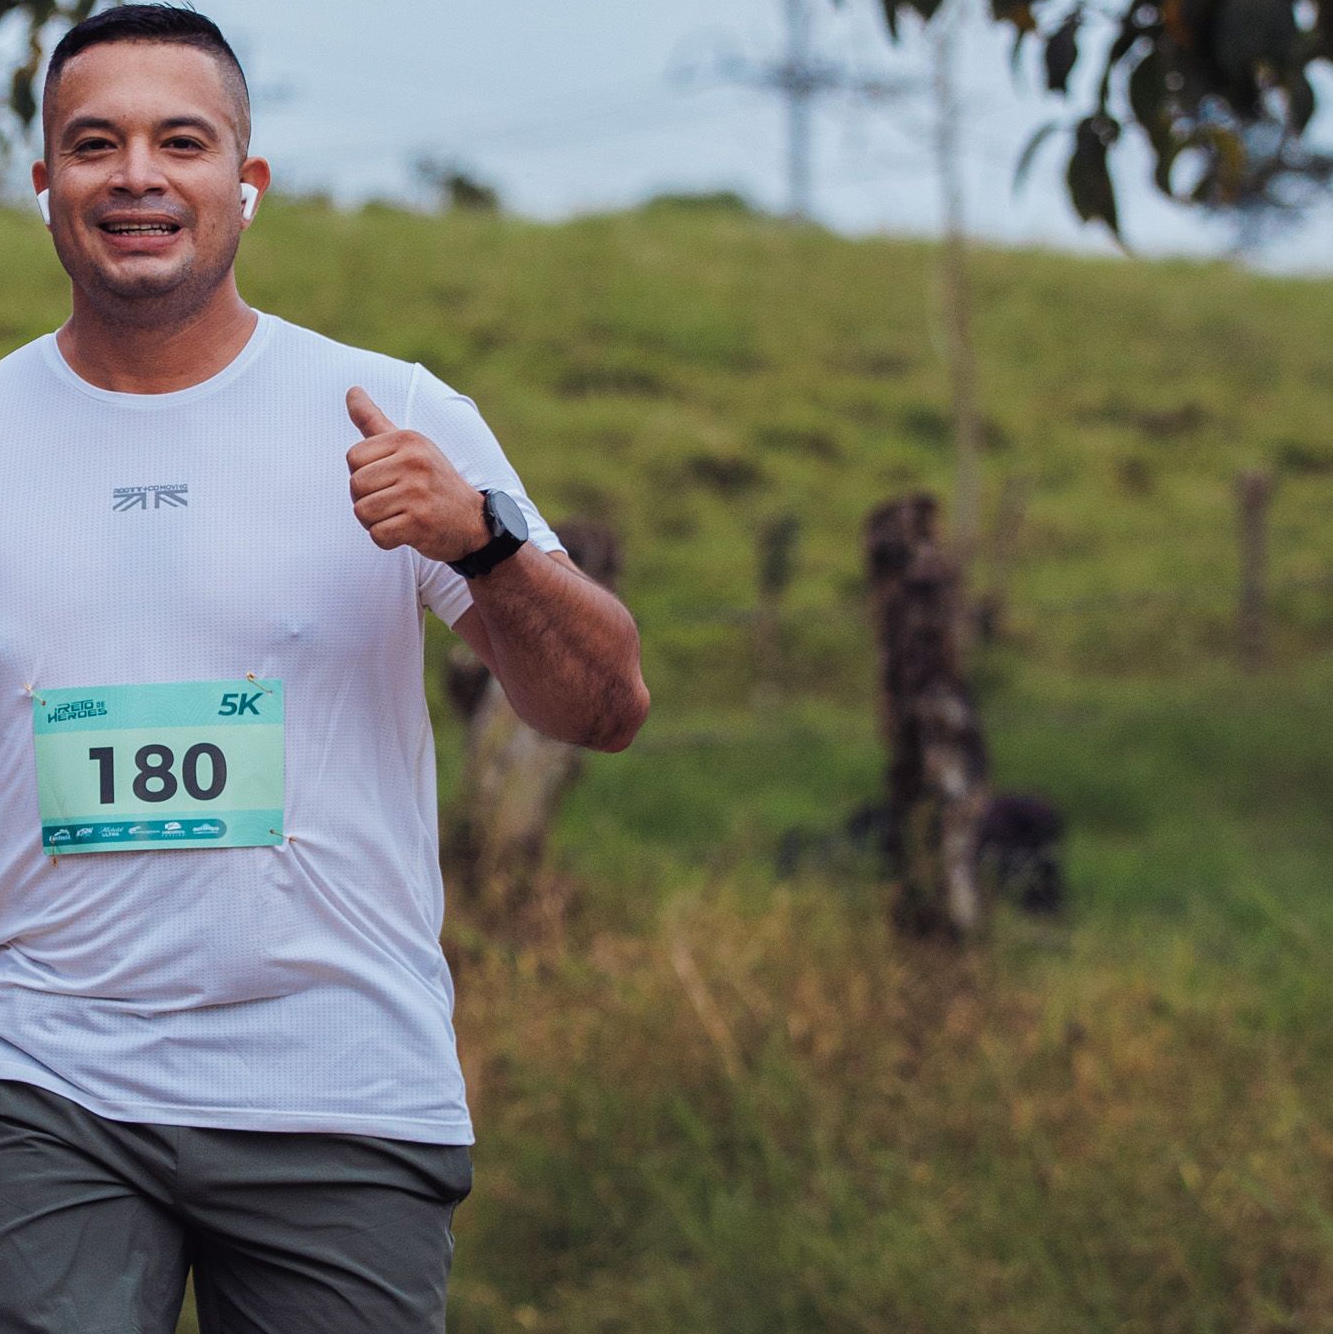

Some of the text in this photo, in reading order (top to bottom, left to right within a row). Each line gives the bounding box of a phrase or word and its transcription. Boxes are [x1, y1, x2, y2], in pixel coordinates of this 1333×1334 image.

[57, 699, 94, 713] RETO
[218, 692, 263, 716] 5K
[89, 742, 227, 804] 180
